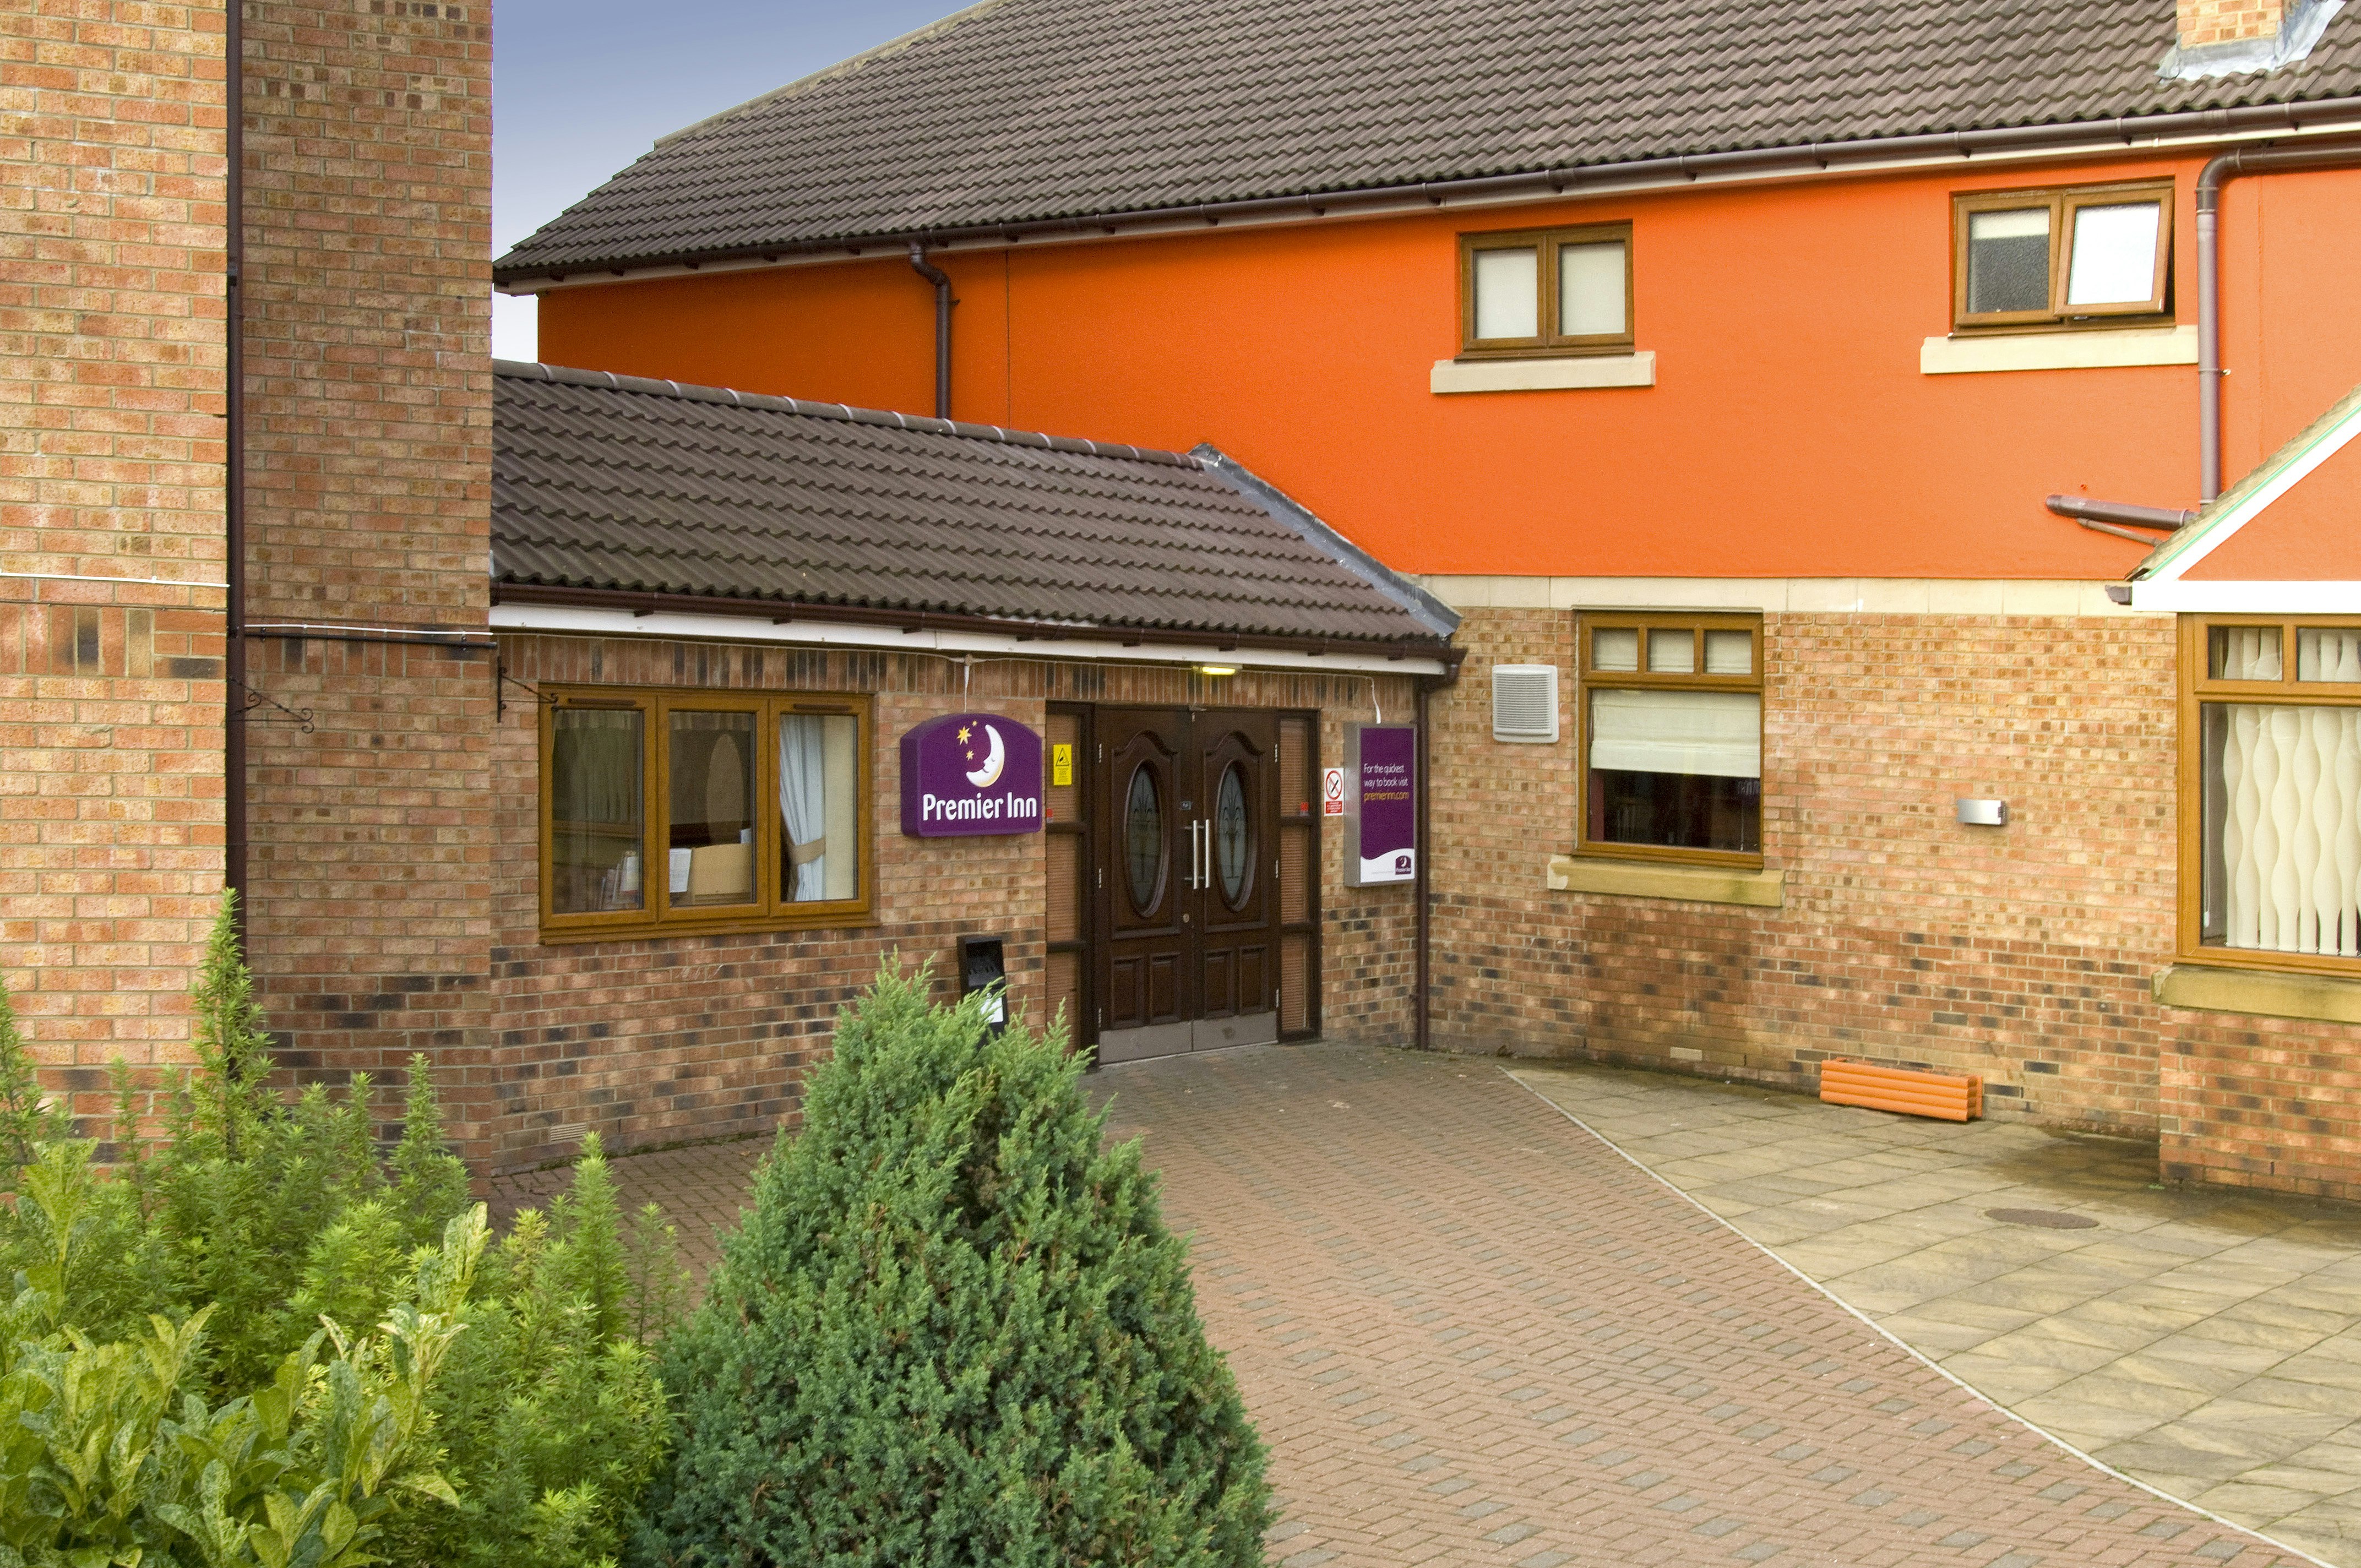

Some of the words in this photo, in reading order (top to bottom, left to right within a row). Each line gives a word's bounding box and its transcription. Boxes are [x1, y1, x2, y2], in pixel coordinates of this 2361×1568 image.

[1363, 763, 1374, 774] For
[1374, 763, 1384, 774] the
[1384, 763, 1405, 776] quickest
[1363, 779, 1376, 790] way
[1376, 778, 1383, 787] to
[1383, 776, 1398, 787] book
[1399, 776, 1408, 787] visit
[923, 792, 1004, 821] Premier
[1007, 792, 1037, 818] Inn
